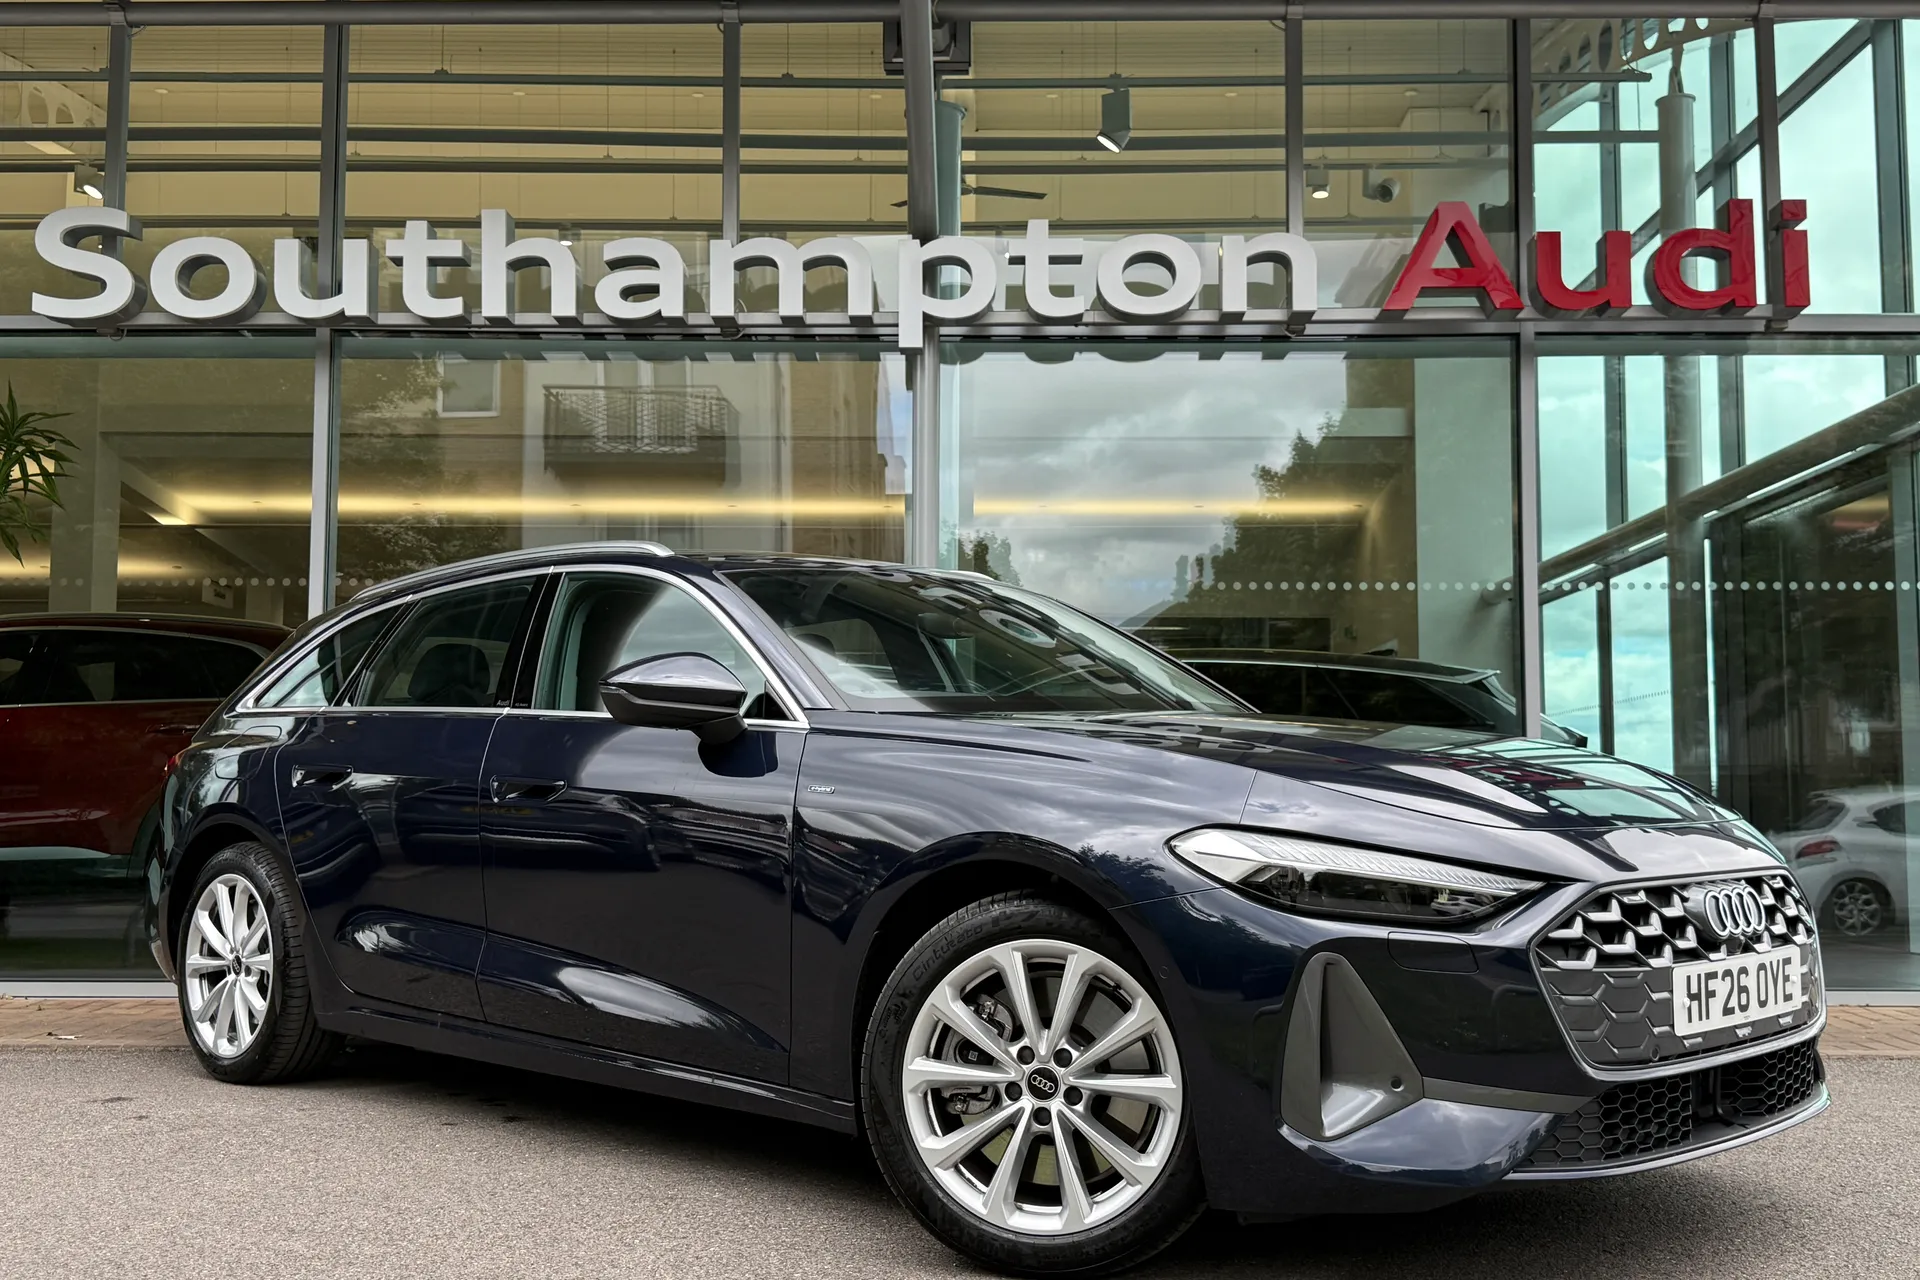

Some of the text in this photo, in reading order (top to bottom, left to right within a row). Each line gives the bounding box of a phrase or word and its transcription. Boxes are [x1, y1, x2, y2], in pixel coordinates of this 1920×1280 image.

[31, 198, 1811, 347] Southampton Audi
[1686, 957, 1793, 1023] HF26 OYE
